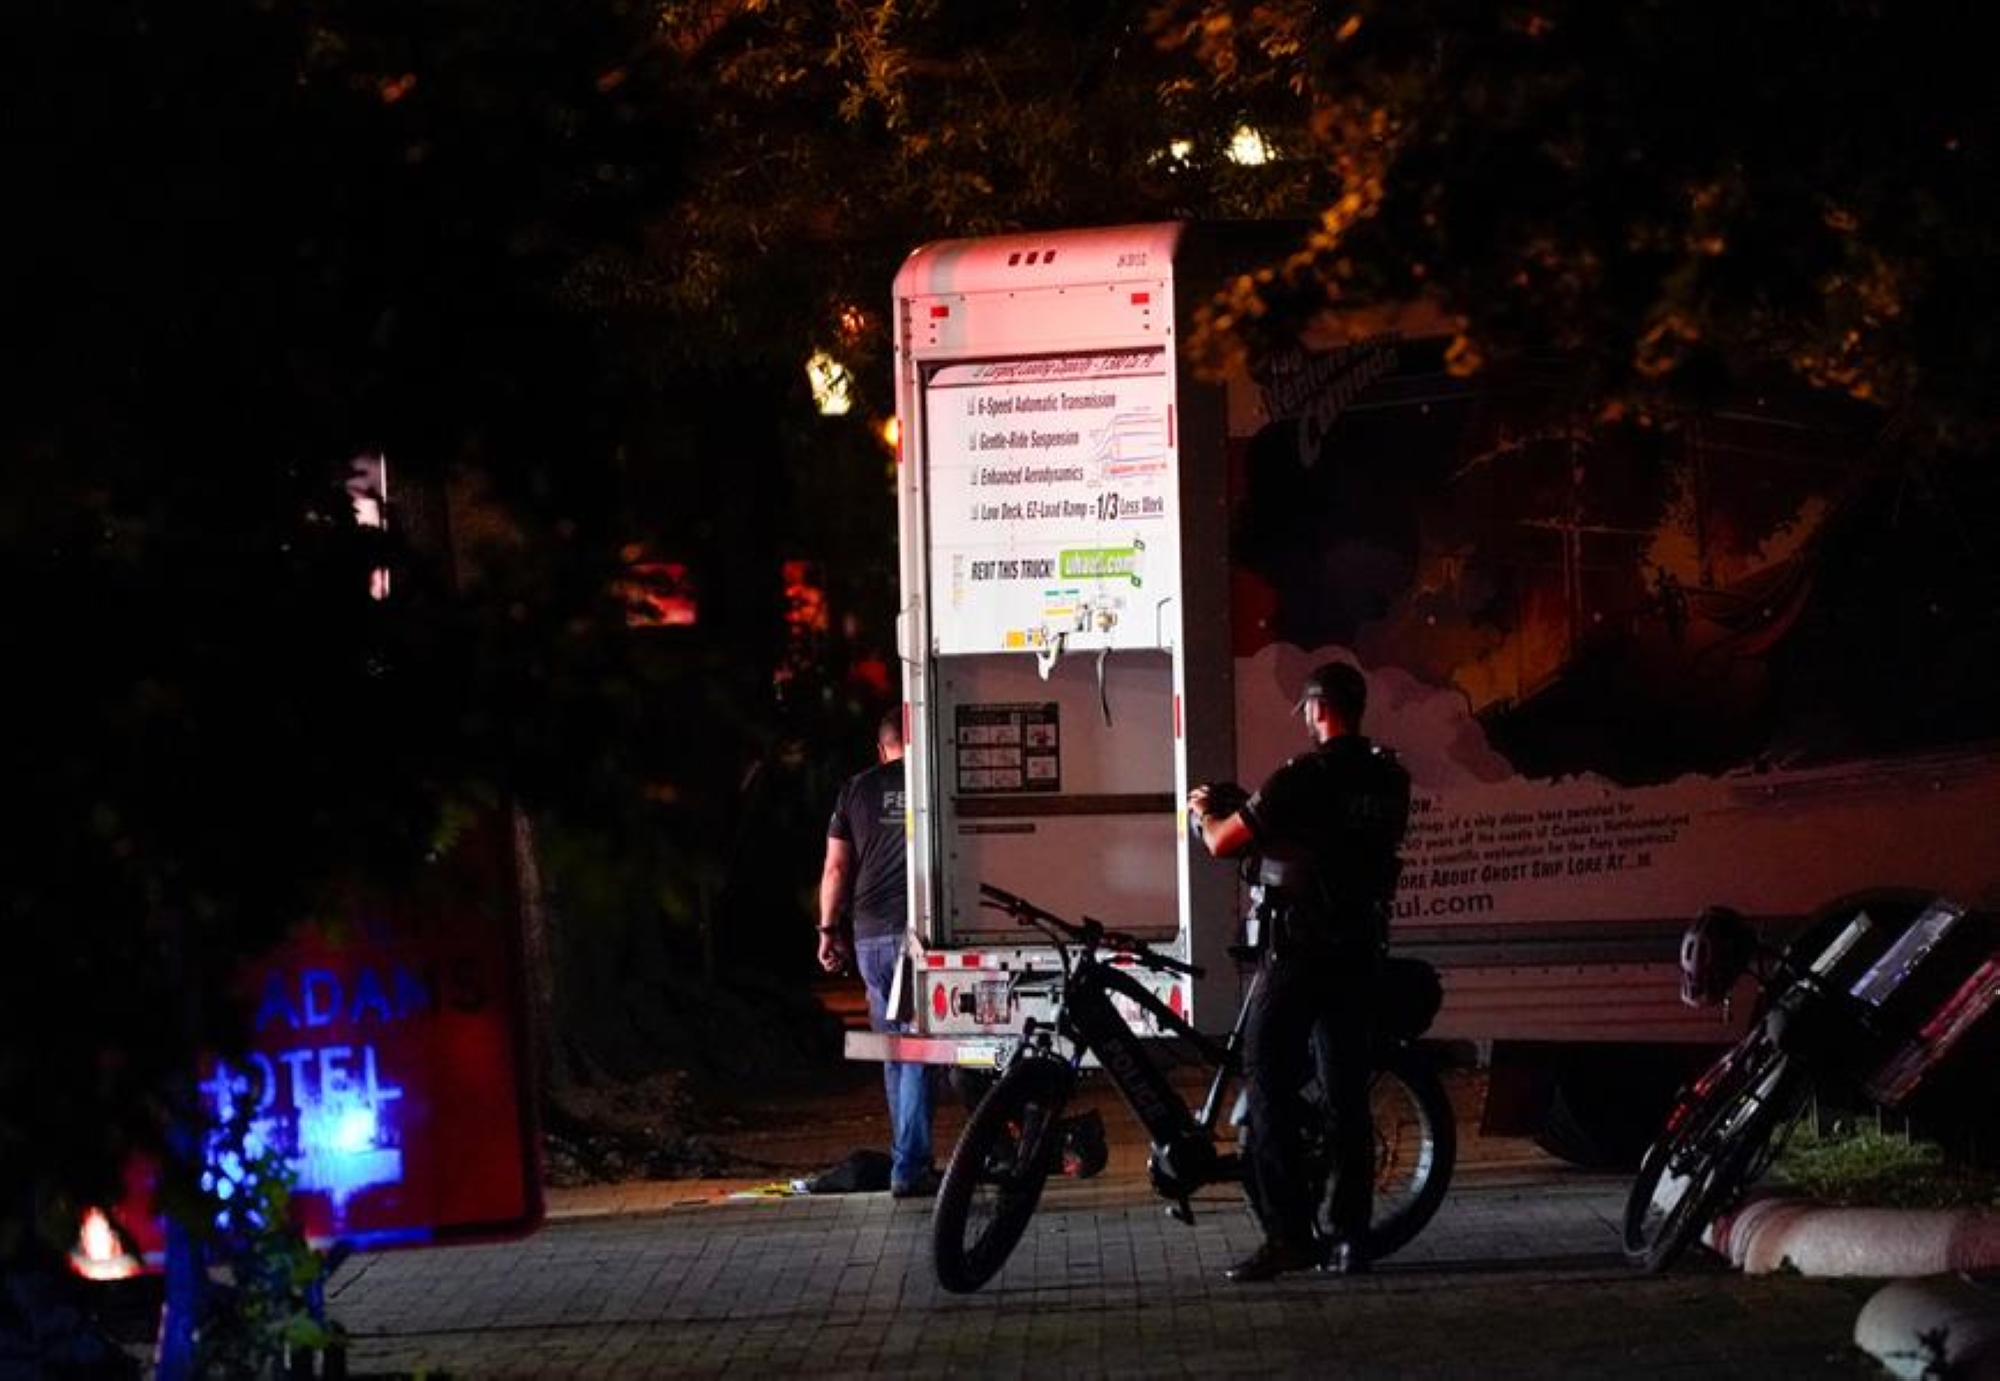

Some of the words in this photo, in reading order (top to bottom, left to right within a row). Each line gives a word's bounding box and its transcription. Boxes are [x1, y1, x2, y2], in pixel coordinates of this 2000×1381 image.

[978, 396, 1013, 418] 6-Speed
[1015, 394, 1058, 412] Automatic
[1061, 392, 1116, 410] Transmission
[980, 430, 1028, 450] Gentle-Ride
[1031, 429, 1079, 450] Suspension
[980, 466, 1022, 486] Enhanced
[1024, 465, 1083, 487] Aerodynamics
[981, 502, 1000, 520] Low
[1027, 500, 1061, 520] EZ-Load
[1063, 499, 1087, 520] Ramp
[1097, 491, 1118, 521] 1/3
[1120, 499, 1140, 514] Less
[1142, 496, 1164, 513] Work
[971, 559, 996, 582] RENT
[997, 559, 1020, 580] THIS
[1021, 558, 1055, 580] TRUCK!
[1474, 813, 1495, 829] ship
[1426, 837, 1452, 851] years
[1458, 831, 1473, 845] off
[1400, 873, 1427, 890] ORE
